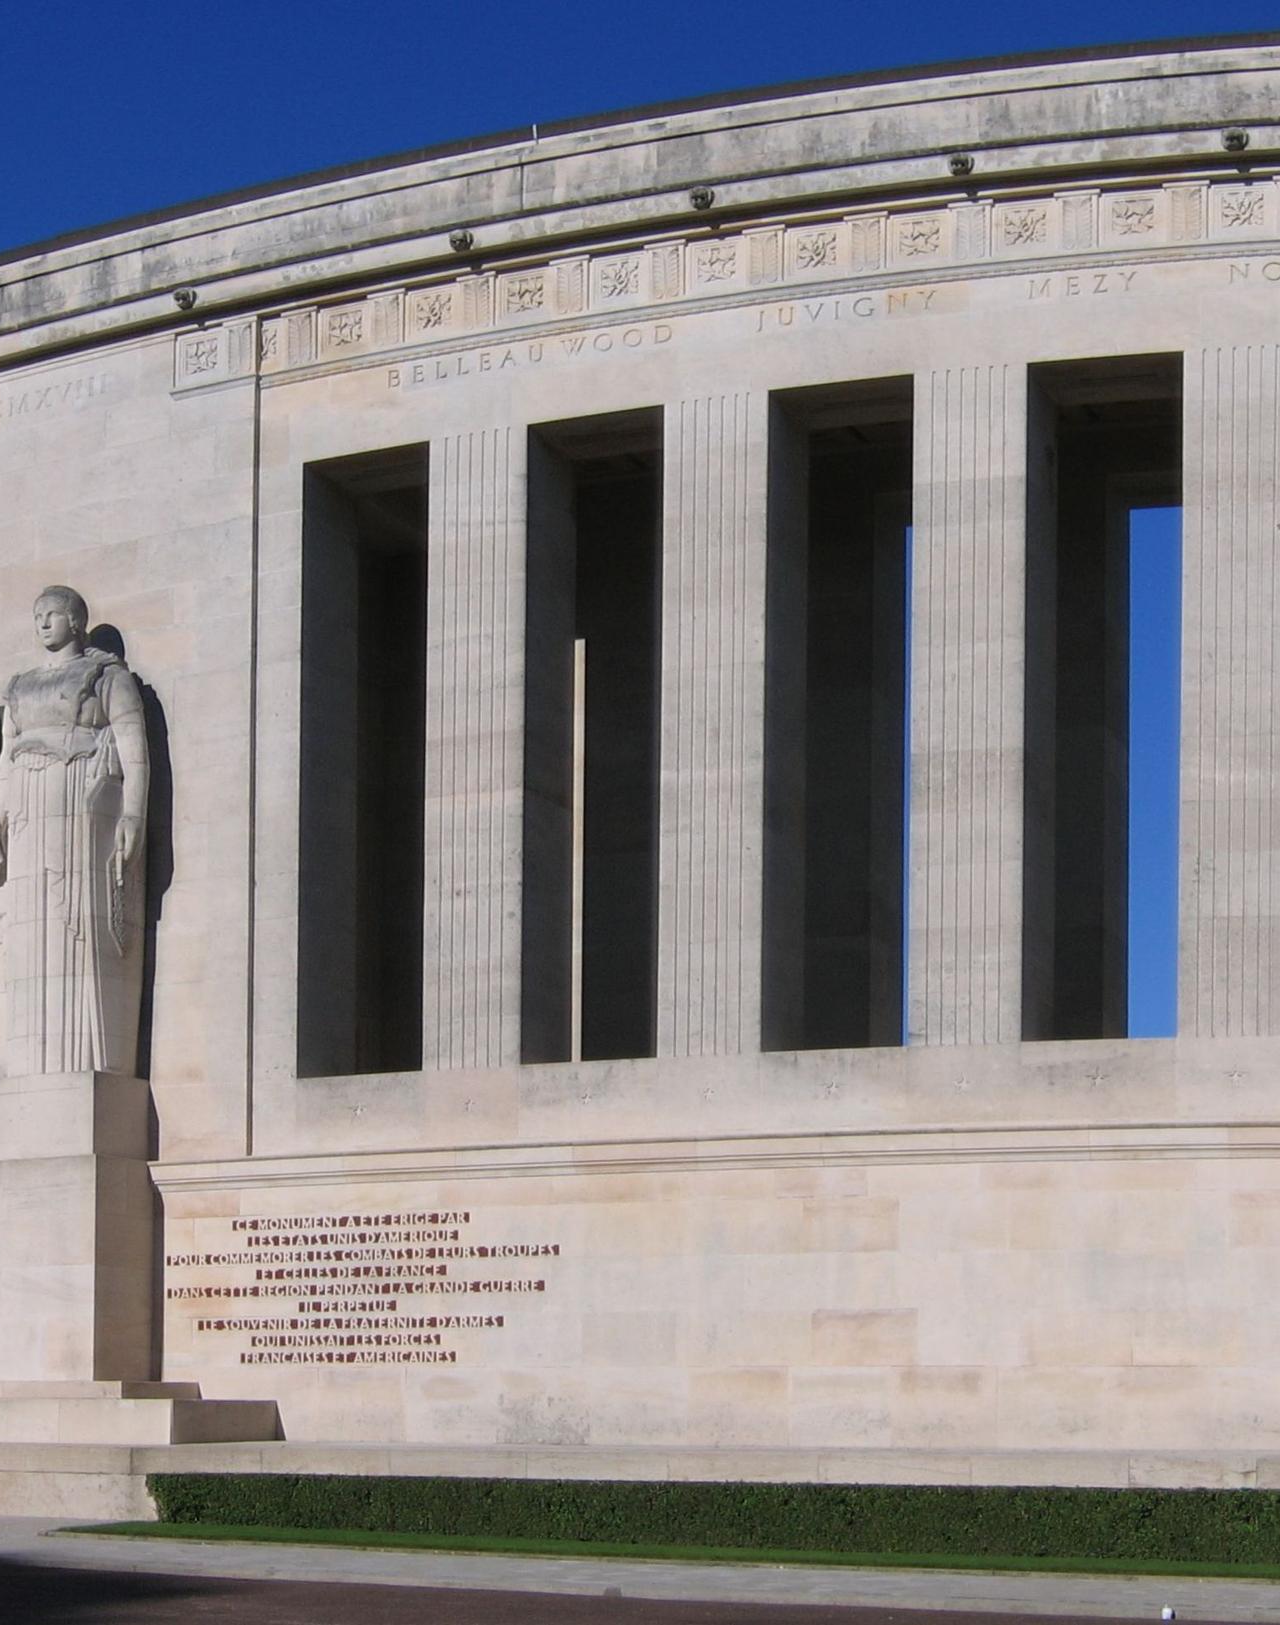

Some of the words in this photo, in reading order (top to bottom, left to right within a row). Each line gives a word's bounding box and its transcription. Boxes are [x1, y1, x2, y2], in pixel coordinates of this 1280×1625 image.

[1028, 271, 1139, 299] MEZY
[755, 289, 938, 334] JUVIGNY
[387, 343, 545, 389] BELLEAU
[560, 323, 674, 357] WOOD
[236, 1219, 253, 1231] CE
[258, 1216, 340, 1230] MONUMENT
[362, 1214, 387, 1226] ETE
[392, 1213, 433, 1225] ERIGE
[438, 1212, 467, 1224] PAR
[252, 1235, 273, 1246] LES
[278, 1233, 320, 1246] ETATS
[327, 1232, 359, 1244] UNIS
[170, 1255, 207, 1266] POUR
[211, 1252, 309, 1265] COMMEMORER
[314, 1251, 335, 1262] LES
[341, 1249, 407, 1261] COMBATS
[413, 1248, 431, 1259] DE
[435, 1247, 479, 1258] LEURS
[487, 1245, 555, 1257] TROUPES
[262, 1269, 277, 1279] ET
[283, 1268, 332, 1279] CELLES
[338, 1267, 356, 1278] DE
[361, 1266, 380, 1277] LA
[384, 1265, 442, 1277] FRANCE
[172, 1287, 207, 1299] DANS
[211, 1286, 255, 1298] CETTE
[259, 1285, 311, 1297] REGION
[316, 1283, 385, 1296] PENDANT
[392, 1283, 409, 1294] LA
[412, 1281, 475, 1294] GRANDE
[479, 1280, 540, 1293] GUERRE
[304, 1302, 316, 1313] IL
[322, 1301, 393, 1312] PERPETUE
[205, 1320, 218, 1331] LE
[223, 1319, 292, 1330] SOUVENIR
[298, 1319, 317, 1329] DE
[322, 1318, 338, 1329] LA
[342, 1316, 431, 1329] FRATERNITE
[255, 1336, 280, 1347] QUI
[285, 1335, 348, 1347] UNISSAIT
[357, 1334, 377, 1346] LES
[381, 1334, 437, 1345] FORCES
[333, 1352, 348, 1363] ET
[354, 1351, 452, 1363] AMERICAINES
